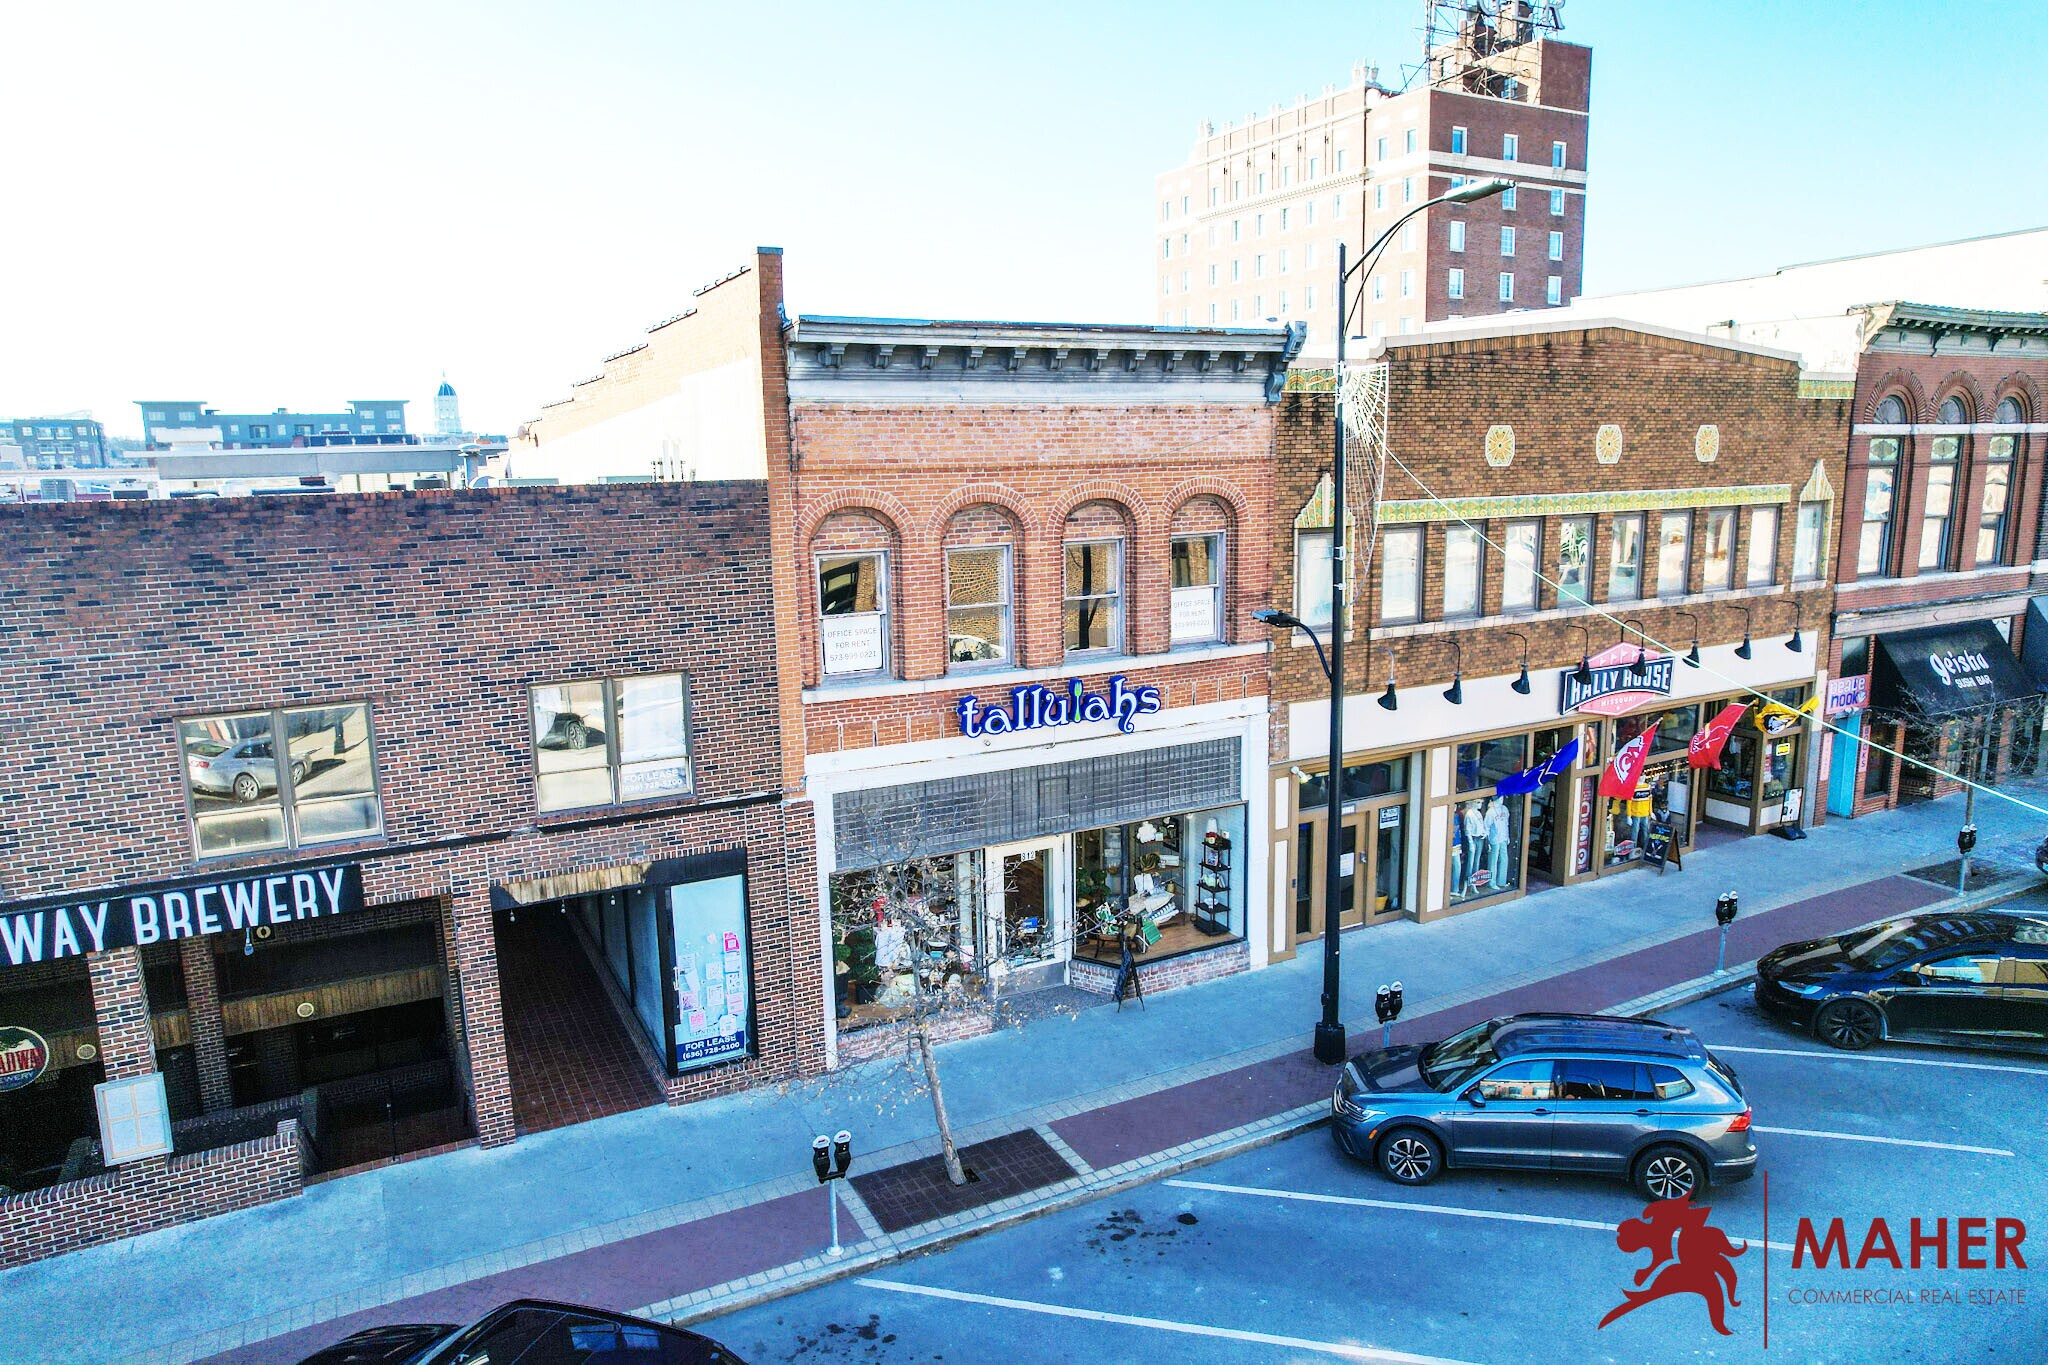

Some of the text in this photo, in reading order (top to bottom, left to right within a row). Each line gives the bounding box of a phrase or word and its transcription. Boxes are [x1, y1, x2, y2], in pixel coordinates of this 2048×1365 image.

[827, 627, 877, 638] OFFICE SPACE
[1929, 649, 1990, 686] geisha
[1955, 674, 1993, 689] SUSHI BAR
[1601, 696, 1637, 706] MISSOURI
[1830, 691, 1858, 708] nook
[1861, 727, 1870, 767] BOOKS
[623, 768, 679, 783] FOR LEASE
[131, 868, 344, 945] BREWERY
[685, 1036, 737, 1051] FOR LEASE
